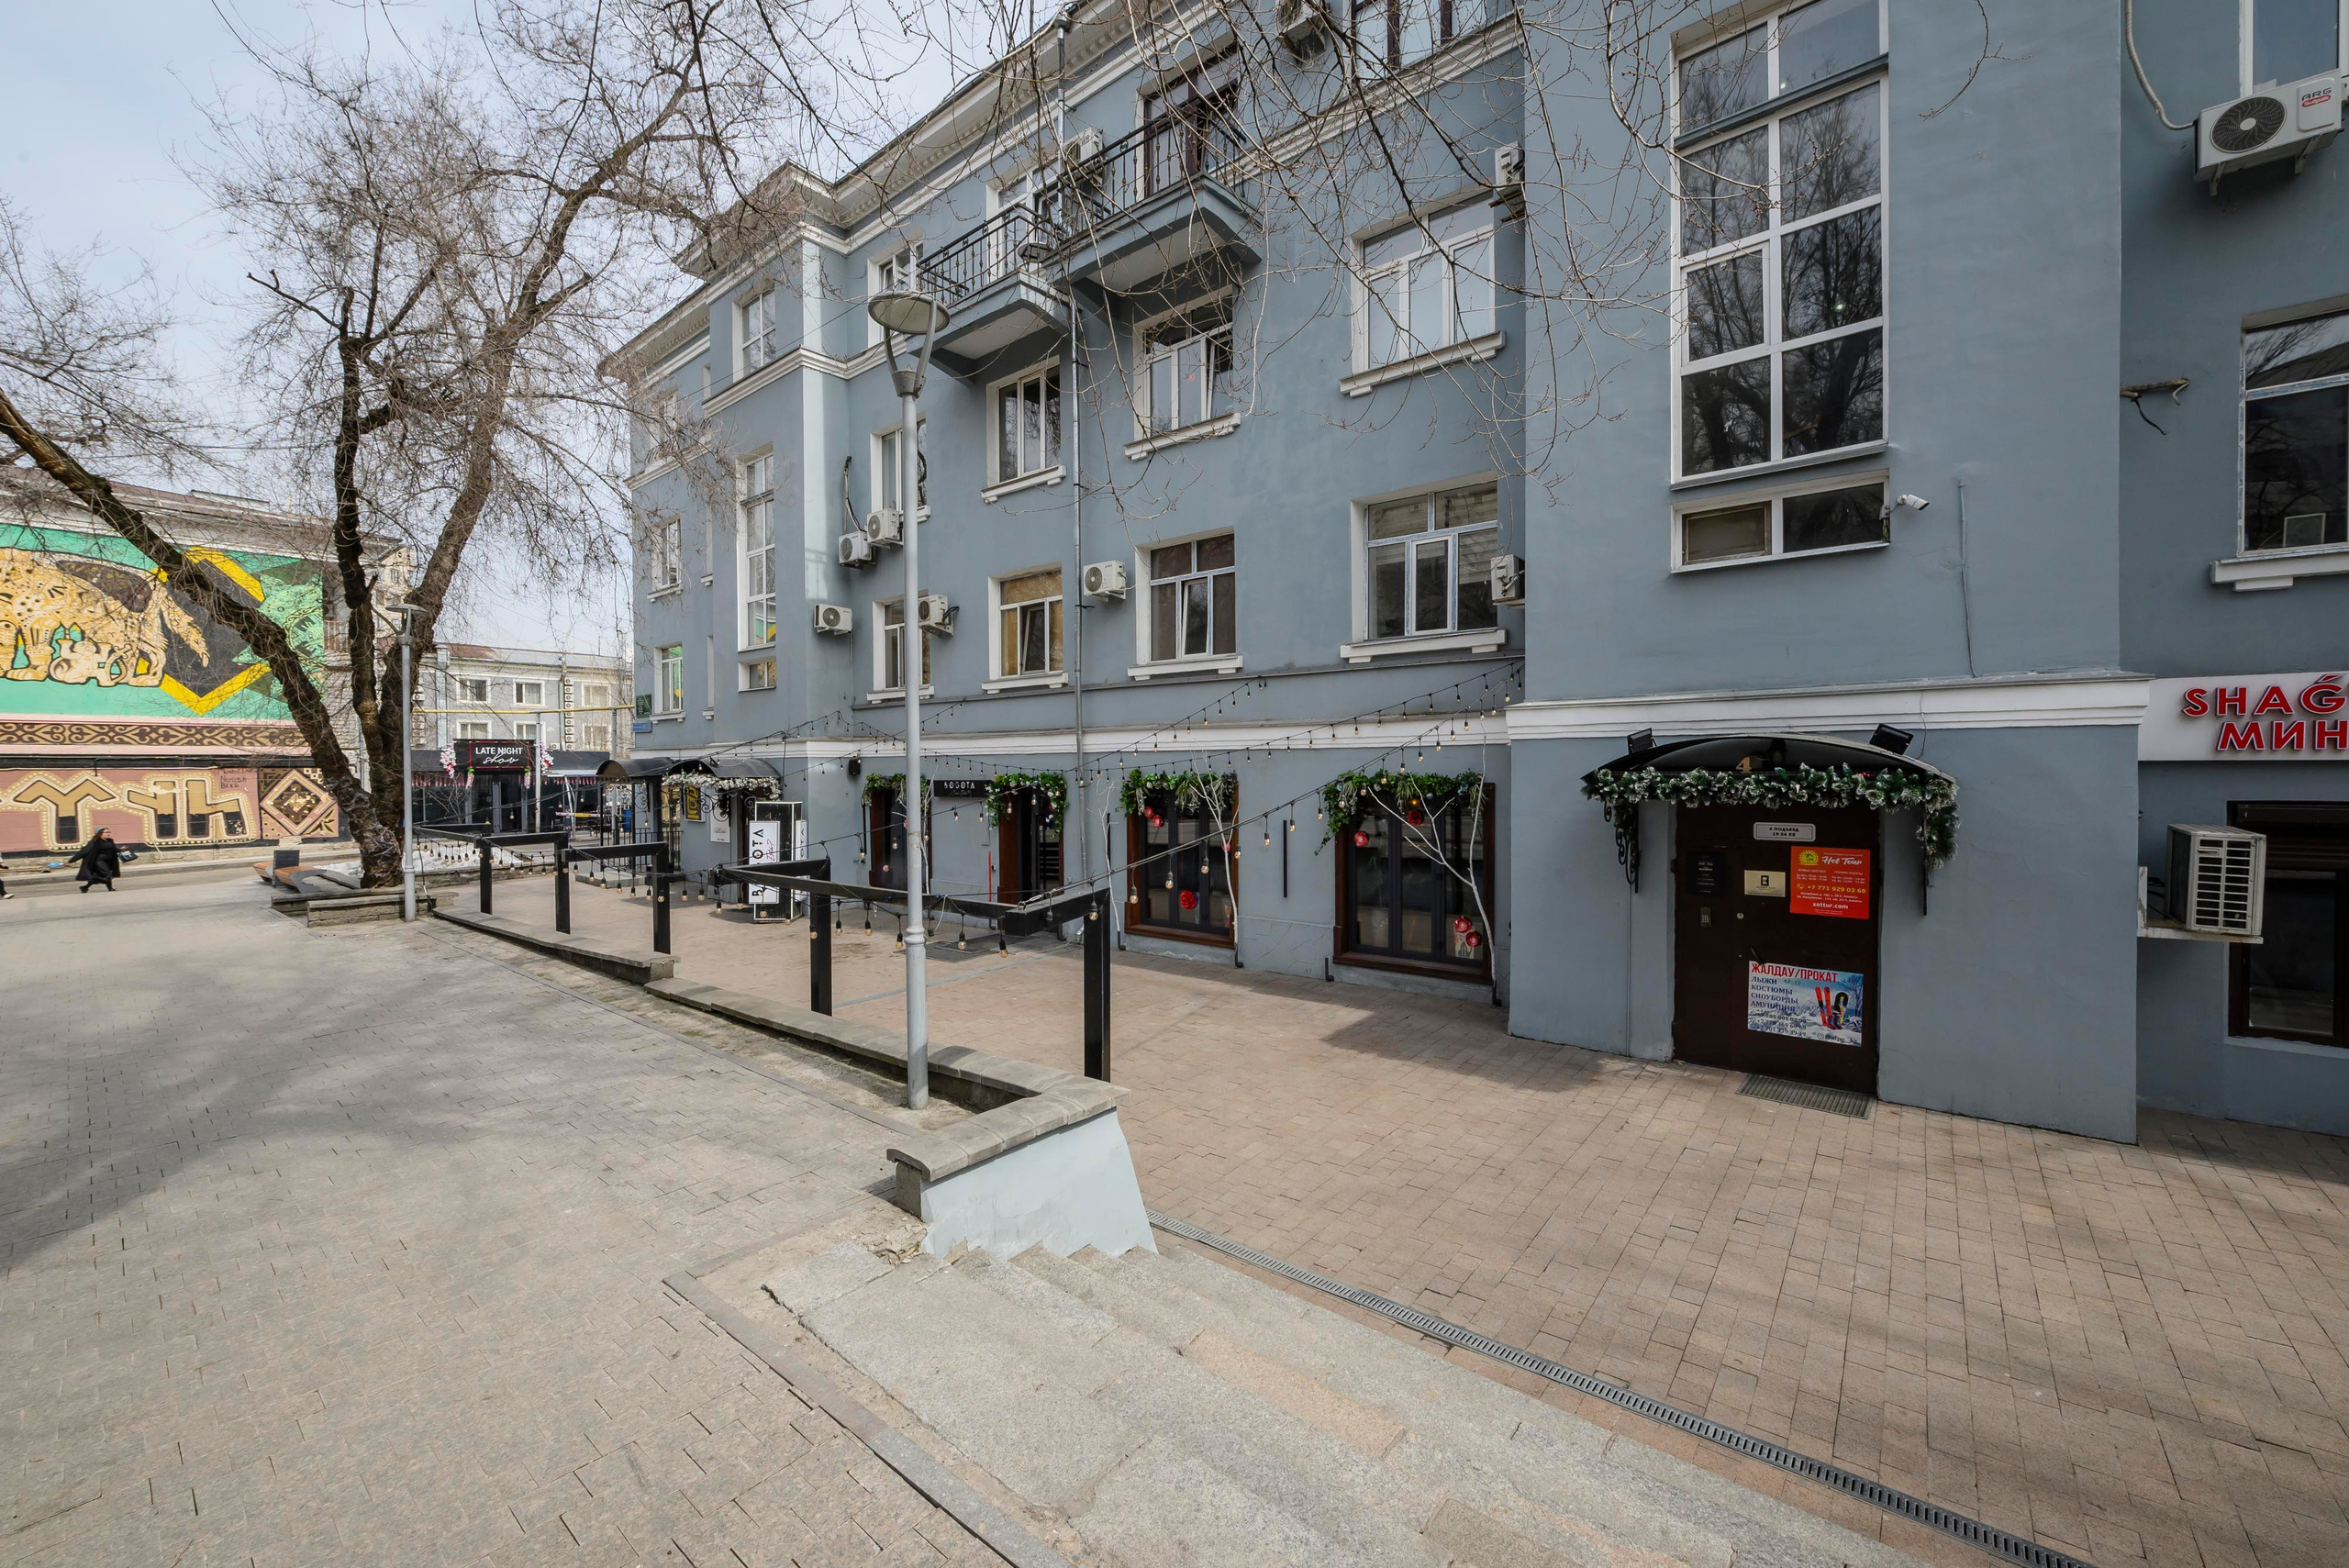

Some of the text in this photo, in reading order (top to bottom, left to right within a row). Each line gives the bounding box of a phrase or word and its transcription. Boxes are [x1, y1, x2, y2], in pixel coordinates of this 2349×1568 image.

[2301, 87, 2332, 101] ARG
[2183, 674, 2348, 717] SHAǴ
[2217, 720, 2349, 751] МИН
[475, 747, 523, 755] LATE NIGHT
[1735, 757, 1753, 773] 4
[943, 781, 975, 789] BOGOTA
[751, 828, 763, 896] BOTA
[1821, 856, 1863, 865] Hot Tour
[1751, 976, 1777, 984] ЛЫЖИ
[1751, 984, 1793, 995] КОСТЮМЫ
[1751, 993, 1798, 1004] СНОУБОРДЫ
[1750, 1001, 1796, 1013] АМУНИЦИЯ
